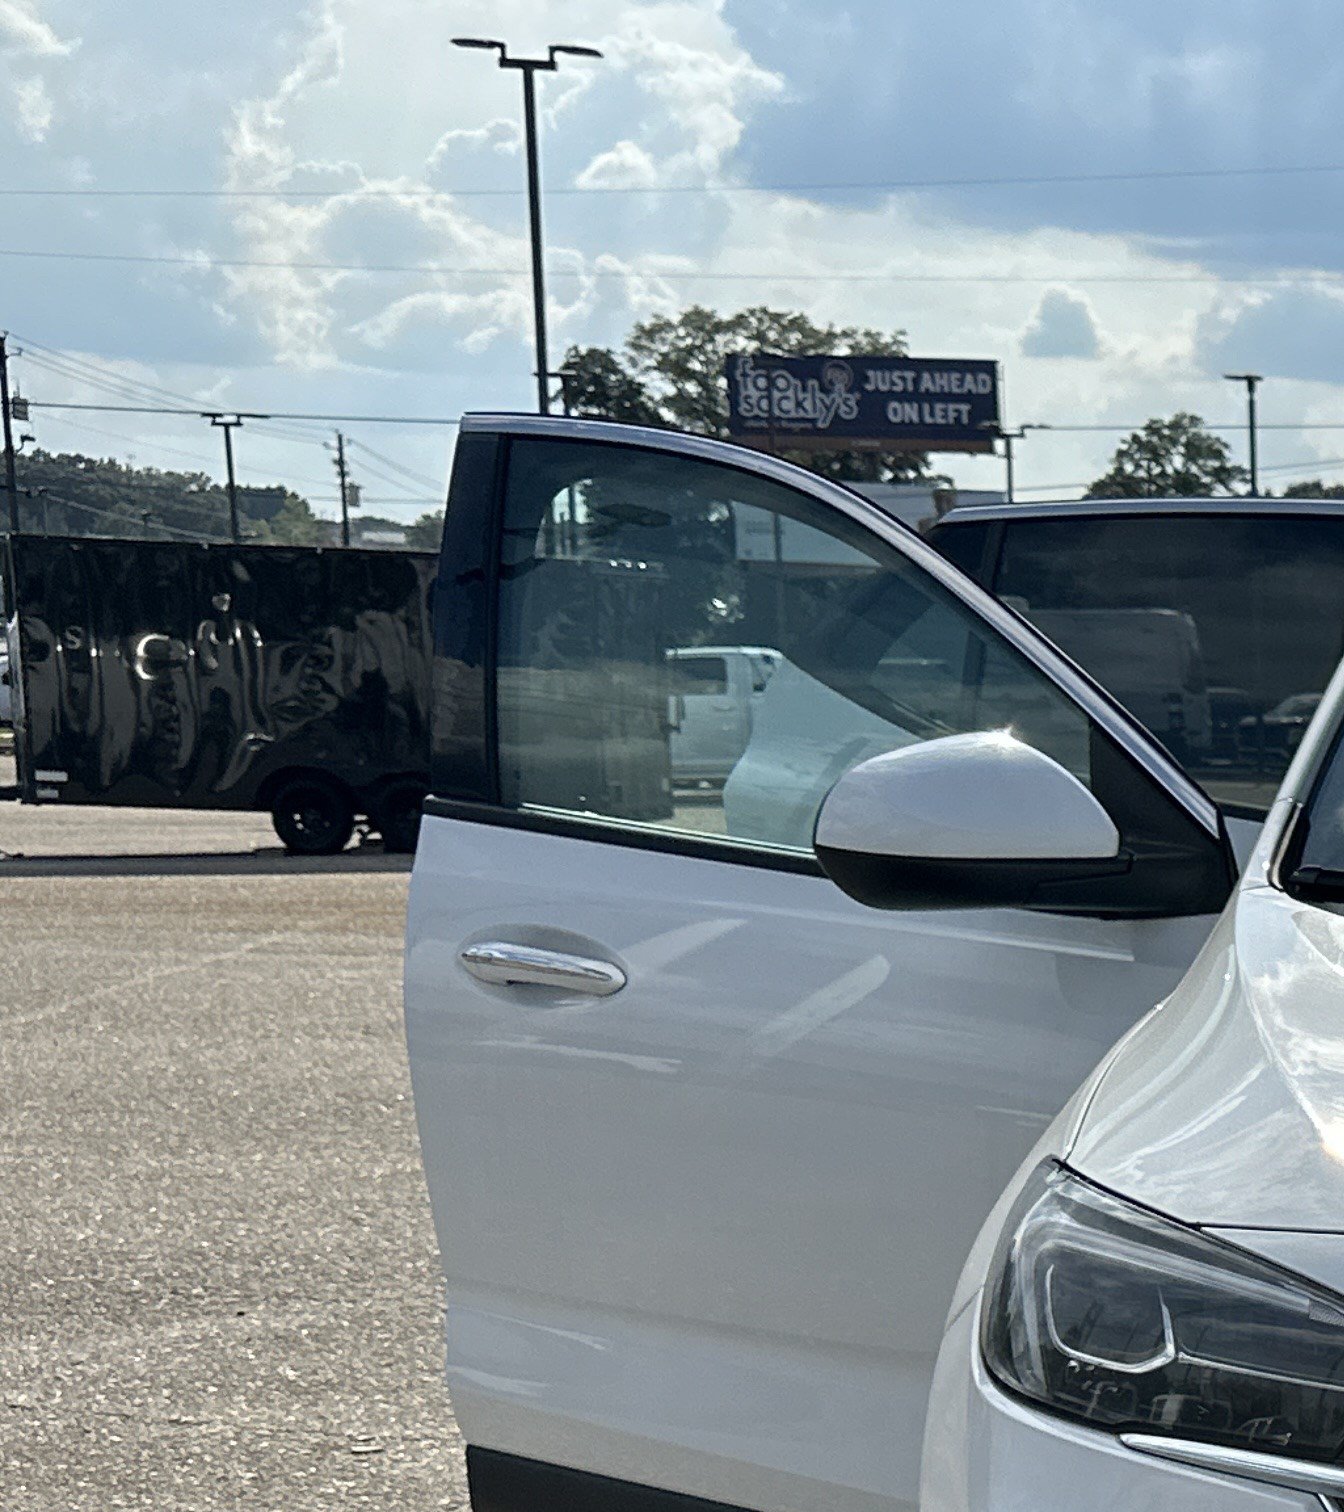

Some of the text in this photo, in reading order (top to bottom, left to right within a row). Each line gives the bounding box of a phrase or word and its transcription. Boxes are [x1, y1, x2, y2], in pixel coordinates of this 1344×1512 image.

[864, 370, 992, 396] JUST AHEAD
[886, 402, 973, 426] ON LEFT
